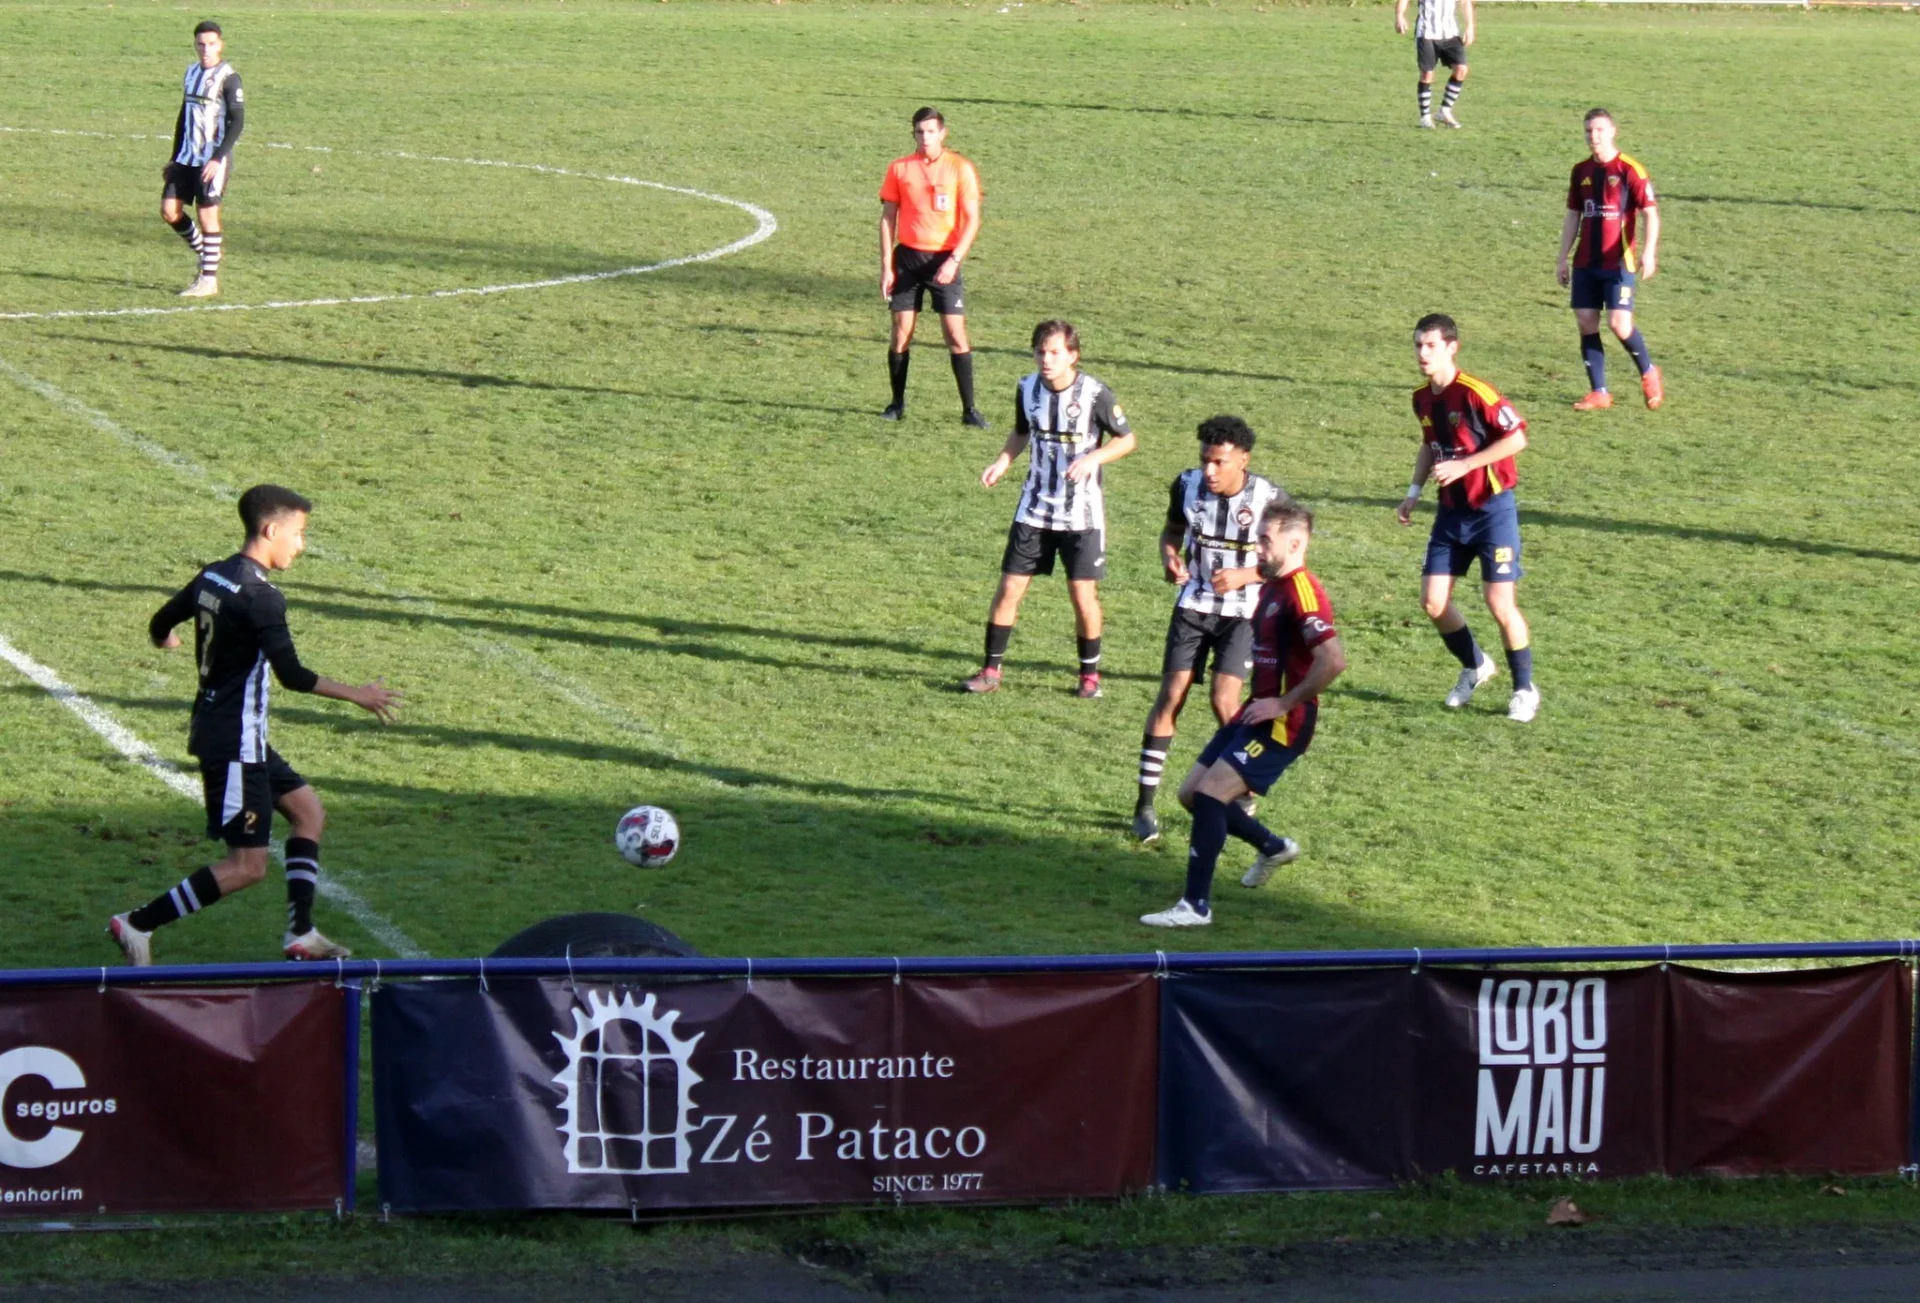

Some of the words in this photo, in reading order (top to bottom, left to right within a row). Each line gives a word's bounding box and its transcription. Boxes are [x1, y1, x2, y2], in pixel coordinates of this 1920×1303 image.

[1243, 740, 1264, 758] 10
[243, 811, 258, 834] 2
[1477, 977, 1606, 1065] LOBO
[732, 1048, 956, 1082] Restaurante
[16, 1098, 117, 1121] seguros
[1473, 1067, 1606, 1156] MAU
[700, 1114, 772, 1164] Zé
[796, 1112, 987, 1162] Pataco
[873, 1174, 934, 1193] SINCE
[941, 1172, 984, 1191] 1977
